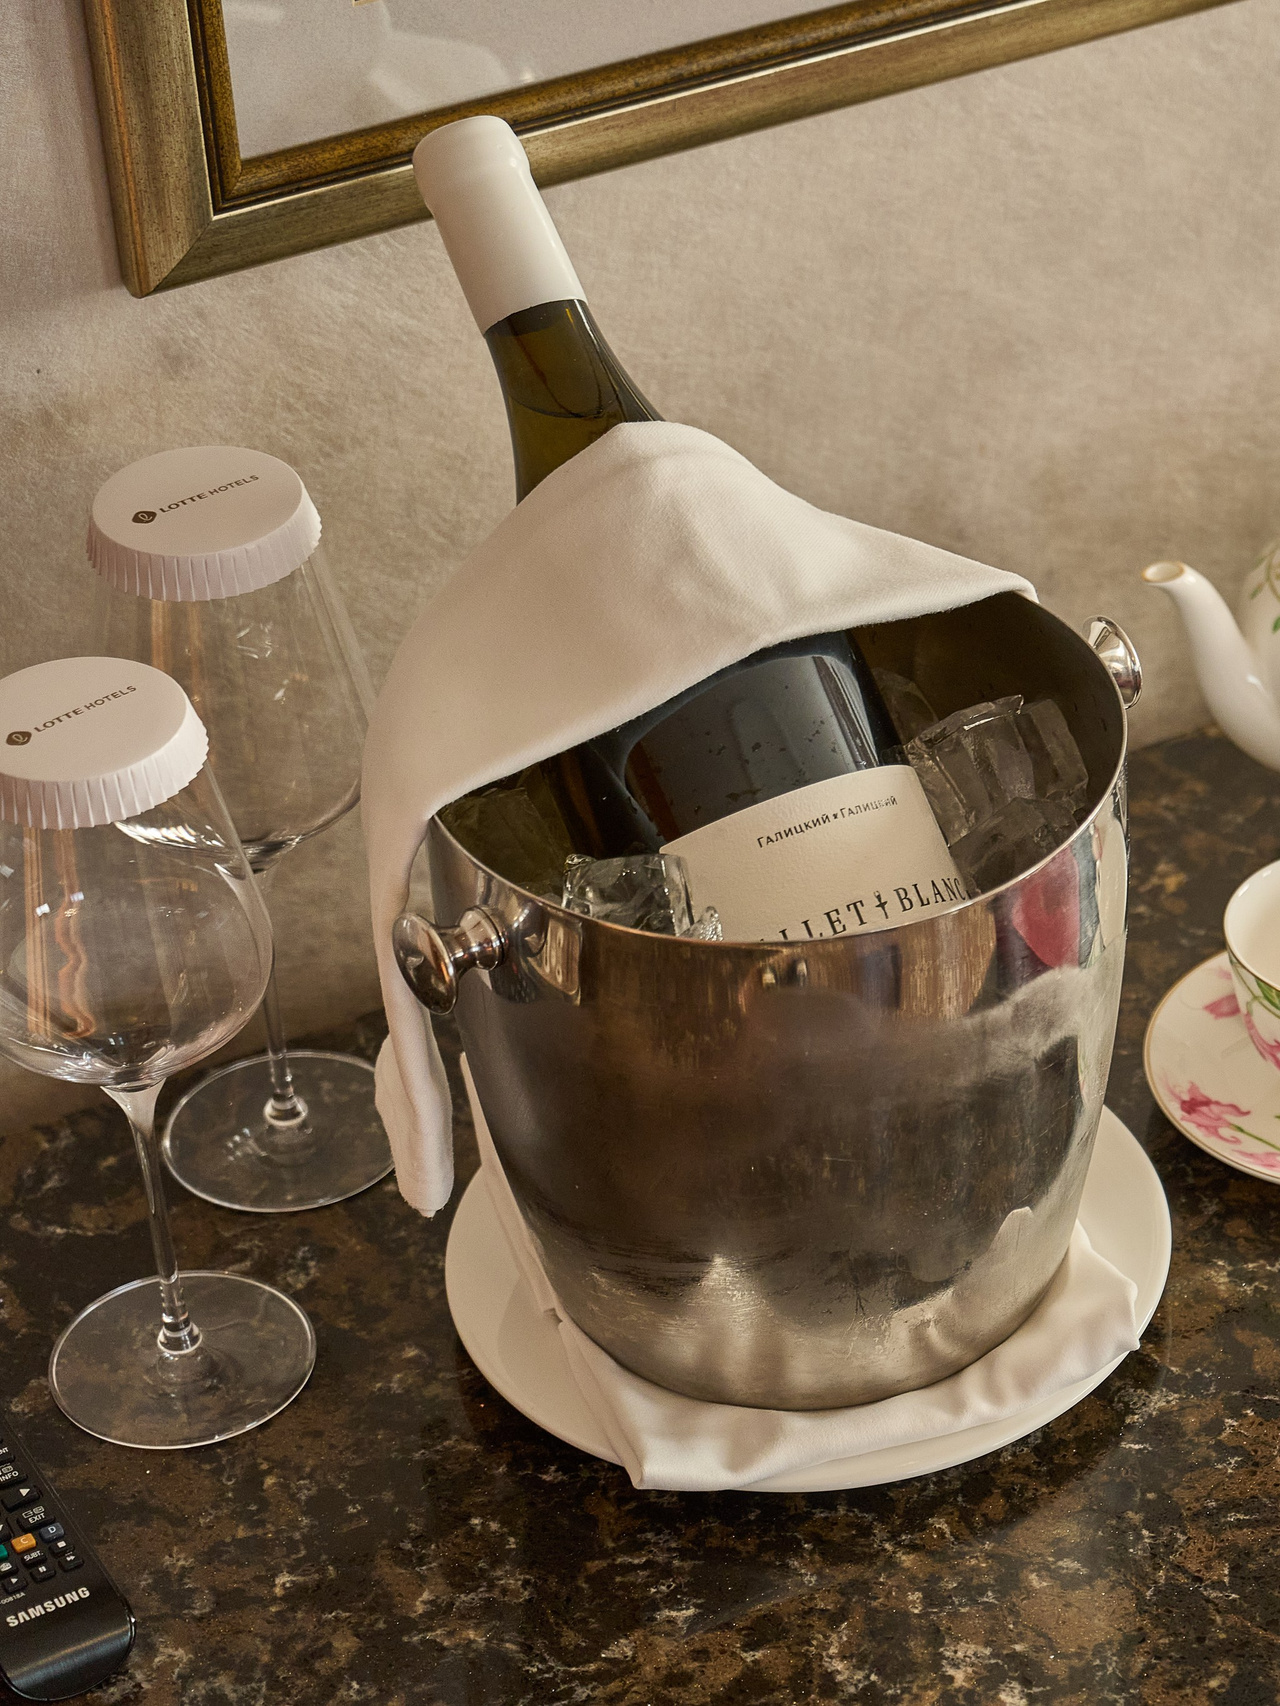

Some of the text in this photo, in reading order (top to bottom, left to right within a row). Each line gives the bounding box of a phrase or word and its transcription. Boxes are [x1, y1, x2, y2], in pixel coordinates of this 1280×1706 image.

[159, 474, 260, 513] LOTTE HOTELS
[34, 685, 137, 733] LOTTE HOTELS
[756, 813, 831, 848] ГАЛИЦКИЙ
[28, 1512, 46, 1524] EXIT
[47, 1526, 57, 1534] D
[6, 1587, 91, 1628] SAMSUNG
